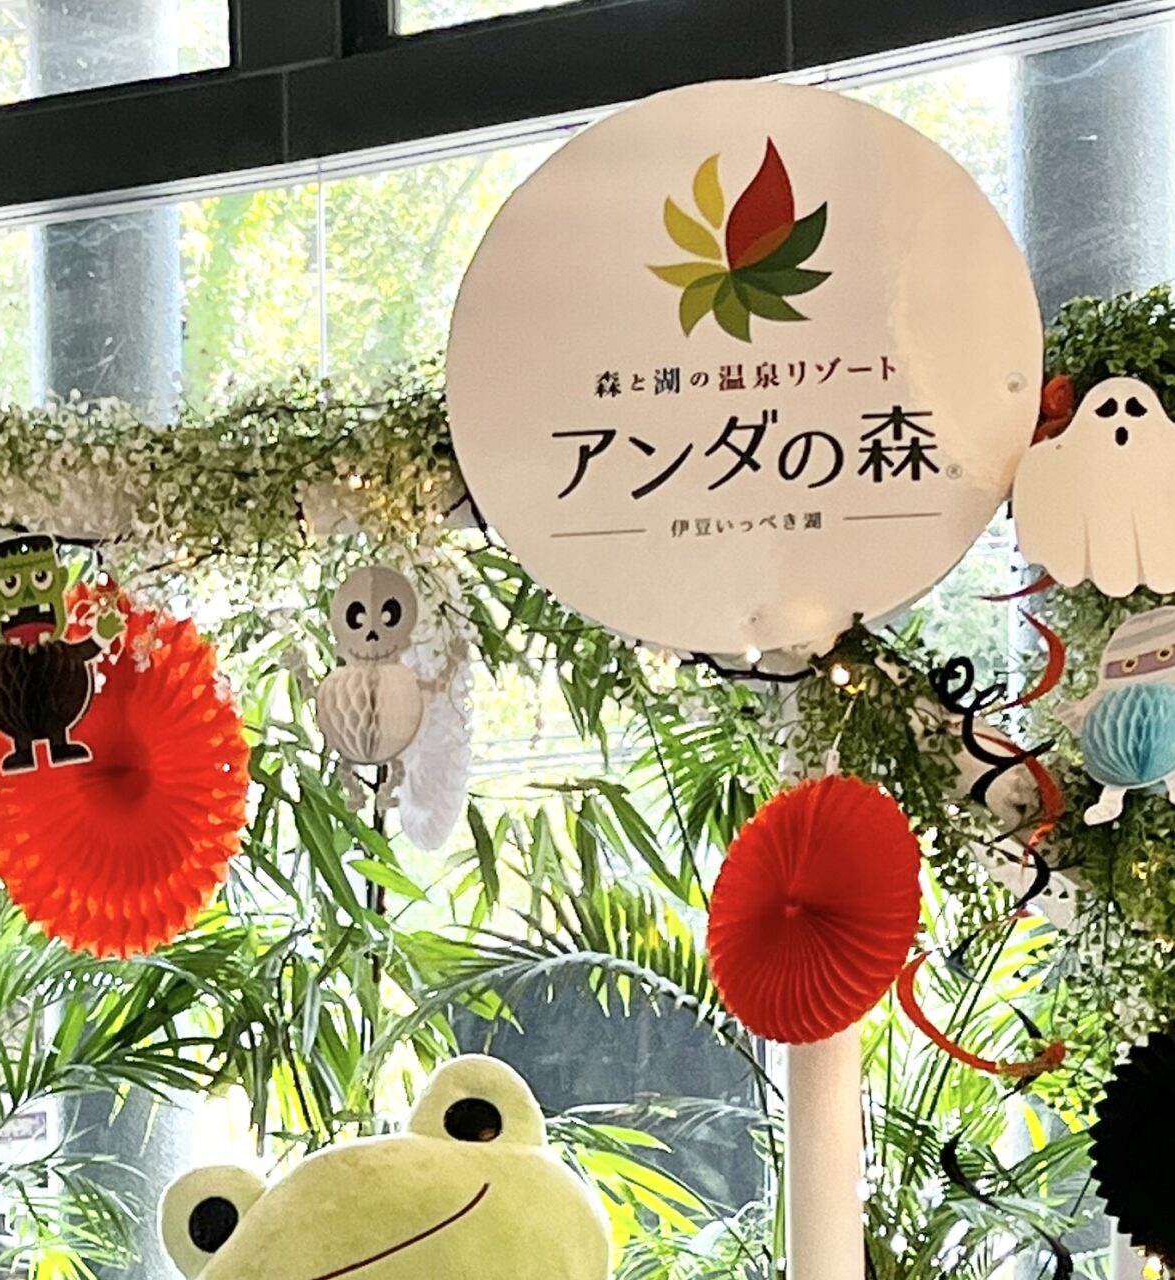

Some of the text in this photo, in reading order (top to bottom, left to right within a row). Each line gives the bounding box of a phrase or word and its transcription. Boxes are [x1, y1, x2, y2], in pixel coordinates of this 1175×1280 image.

[594, 356, 897, 398] 森と湖の温泉リゾート
[551, 405, 941, 499] アンダの森
